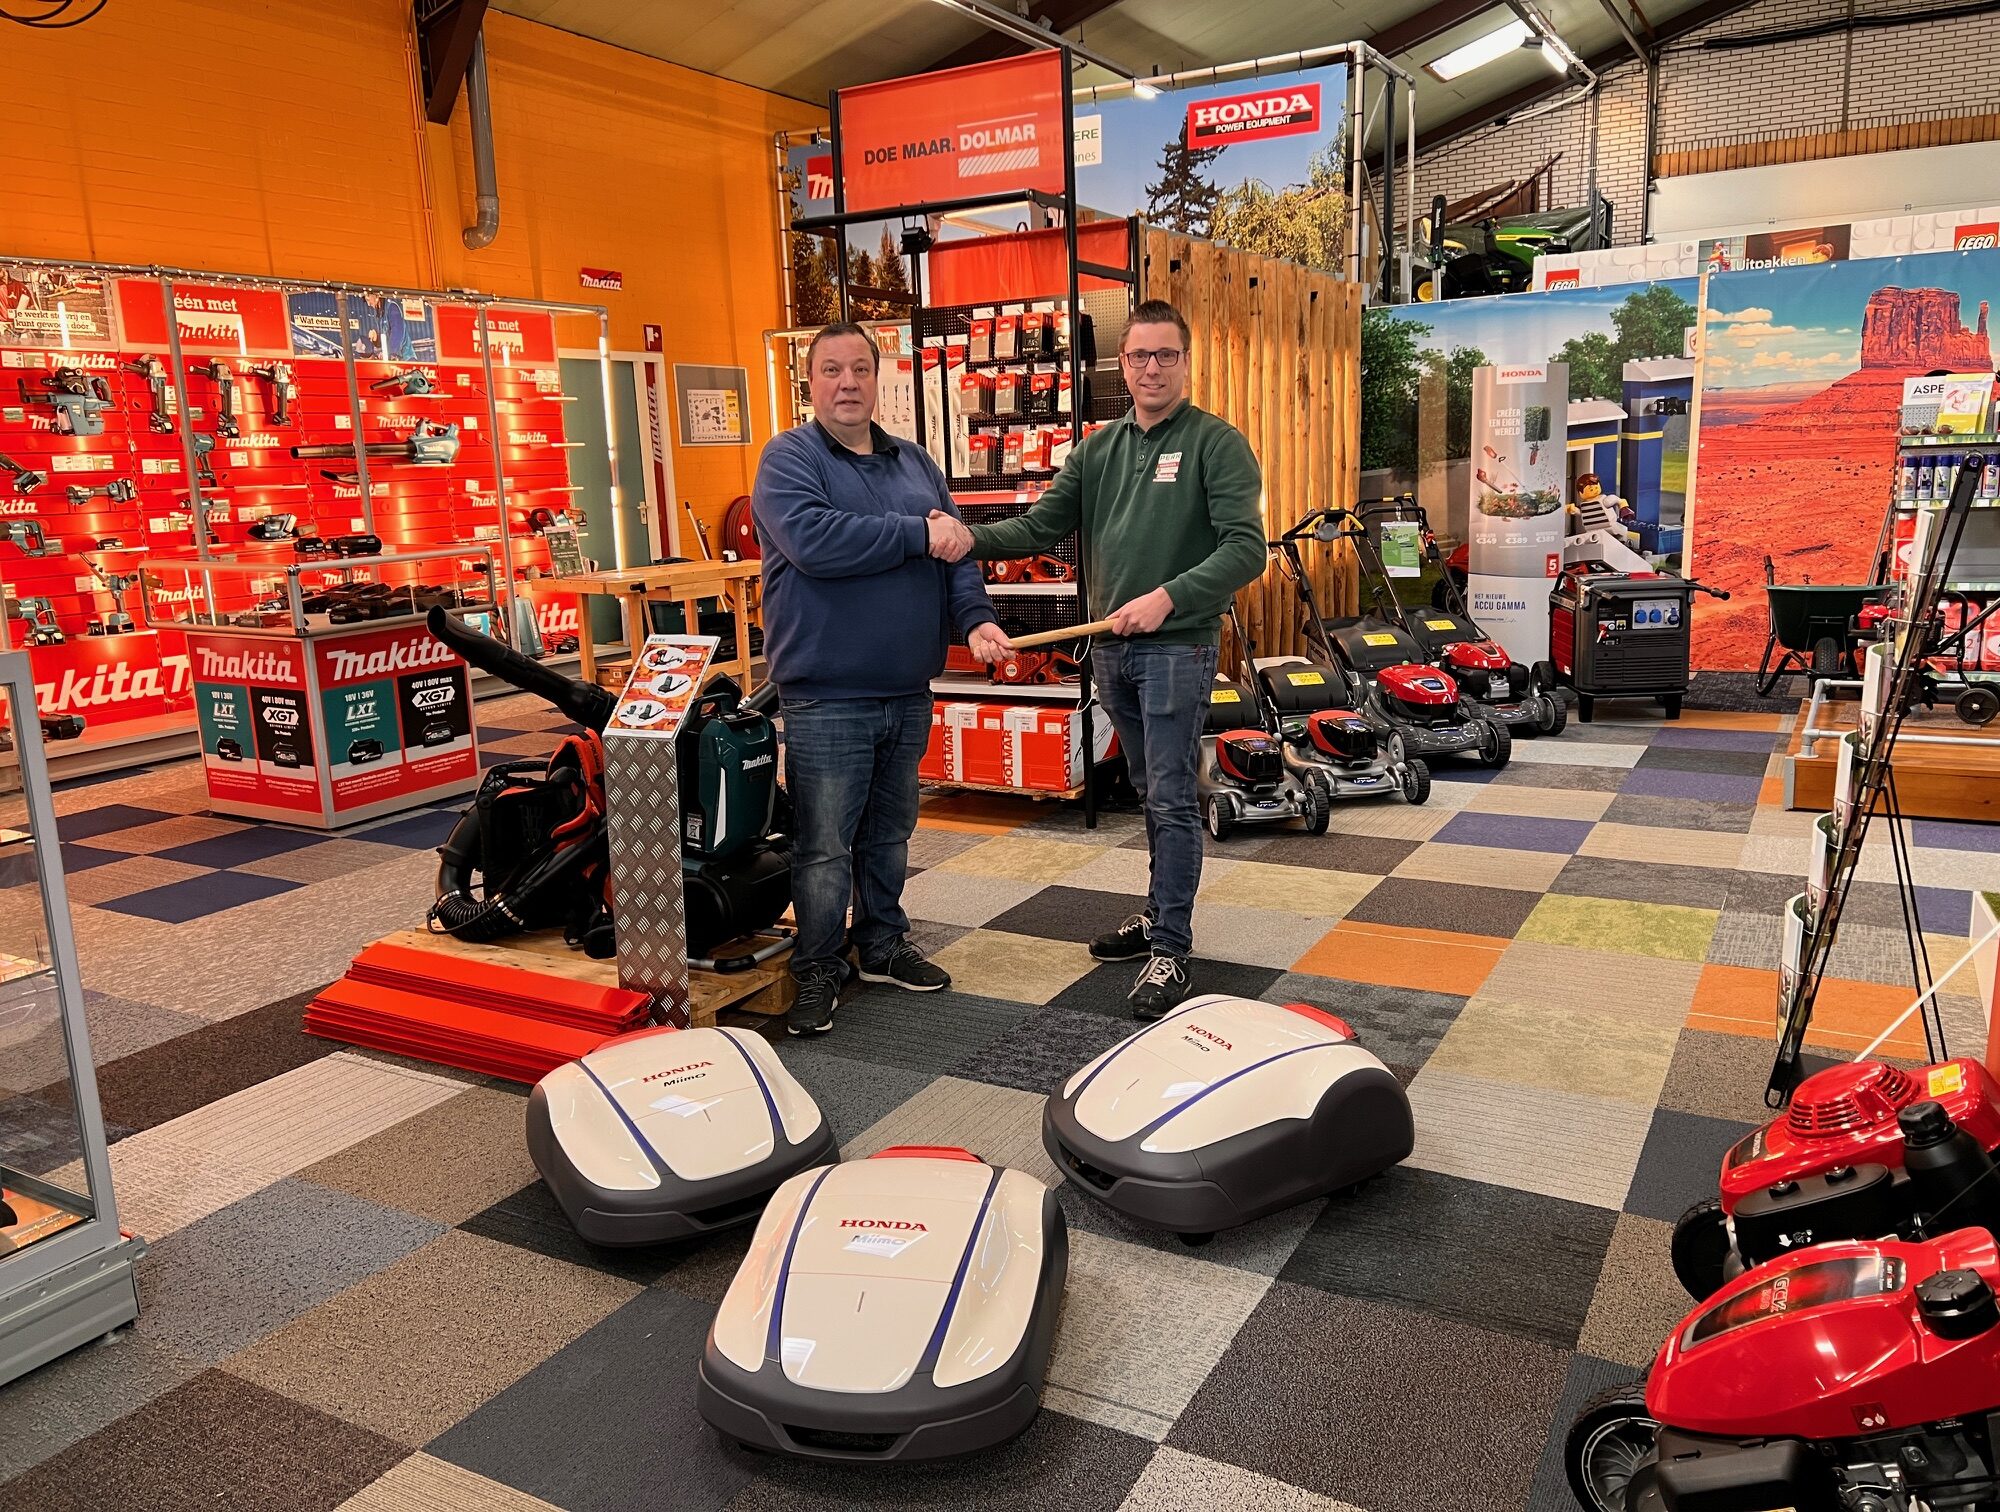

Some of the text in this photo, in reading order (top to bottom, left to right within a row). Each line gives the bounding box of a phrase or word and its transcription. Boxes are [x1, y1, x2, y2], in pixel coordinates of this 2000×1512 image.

[1195, 94, 1312, 126] HONDA
[1216, 115, 1292, 134] POWER EQUIPMENT
[1074, 128, 1099, 141] ERE
[864, 124, 1036, 165] DOE MAAR. DOLMAR
[1958, 234, 1996, 250] LEGO
[1736, 254, 1806, 270] Uitpakken
[206, 298, 238, 312] met
[498, 320, 520, 331] met
[1913, 384, 1944, 394] ASPE
[1548, 558, 1556, 570] 5
[1474, 601, 1526, 610] ACCU GAMMA
[412, 681, 423, 690] 40V
[418, 689, 450, 705] XGT
[213, 702, 235, 718] LXT
[268, 710, 294, 722] XGT
[346, 702, 377, 720] LXT
[945, 725, 1013, 786] DOLMAR DOLMAR
[1064, 714, 1072, 790] DOLMAR
[1186, 1024, 1233, 1051] HONDA
[642, 1060, 714, 1084] HONDA
[840, 1219, 928, 1232] HONDA
